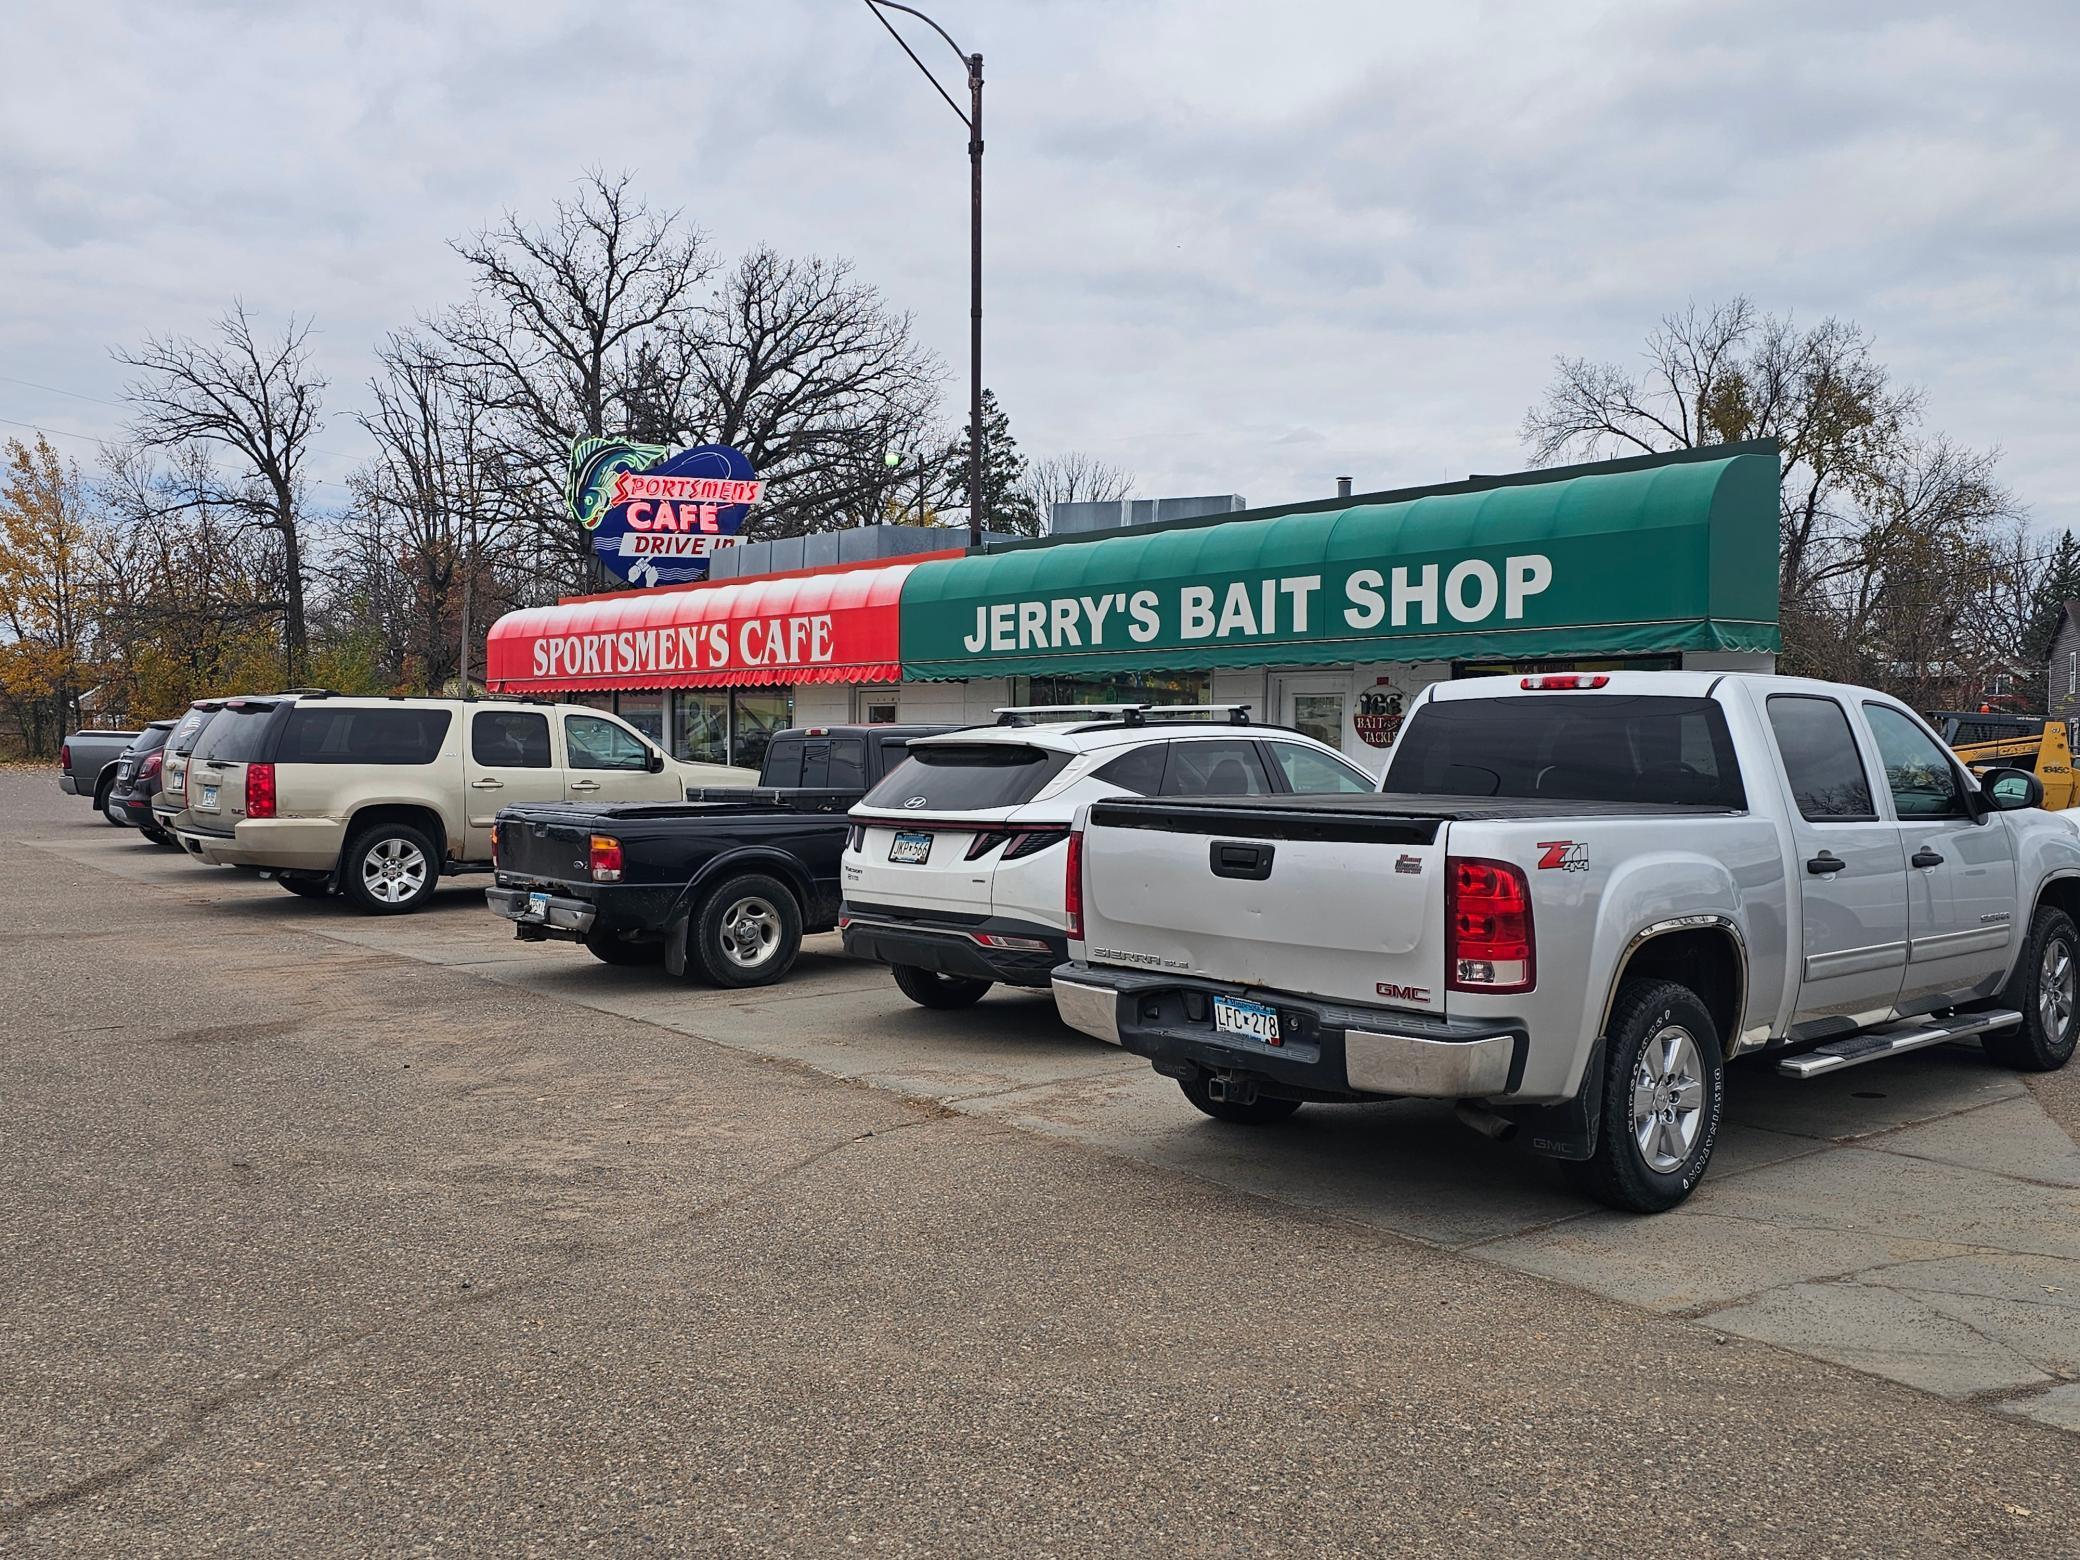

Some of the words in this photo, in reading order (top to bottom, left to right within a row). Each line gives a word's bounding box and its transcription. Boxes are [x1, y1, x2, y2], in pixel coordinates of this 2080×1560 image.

[611, 469, 759, 509] SPORTSMEN'S
[626, 501, 719, 534] CAFE
[634, 536, 706, 555] DRIVE
[963, 592, 1160, 653] JERRY'S
[1180, 575, 1321, 640] BAIT
[1344, 553, 1553, 631] SHOP
[533, 622, 731, 677] SPORTSMEN'S
[739, 614, 834, 667] CAFE
[1357, 717, 1384, 729] BAIT
[1094, 947, 1161, 966] SIERRA
[1376, 982, 1430, 1003] GMC
[1252, 1013, 1277, 1037] 278
[1533, 1137, 1575, 1153] GMC
